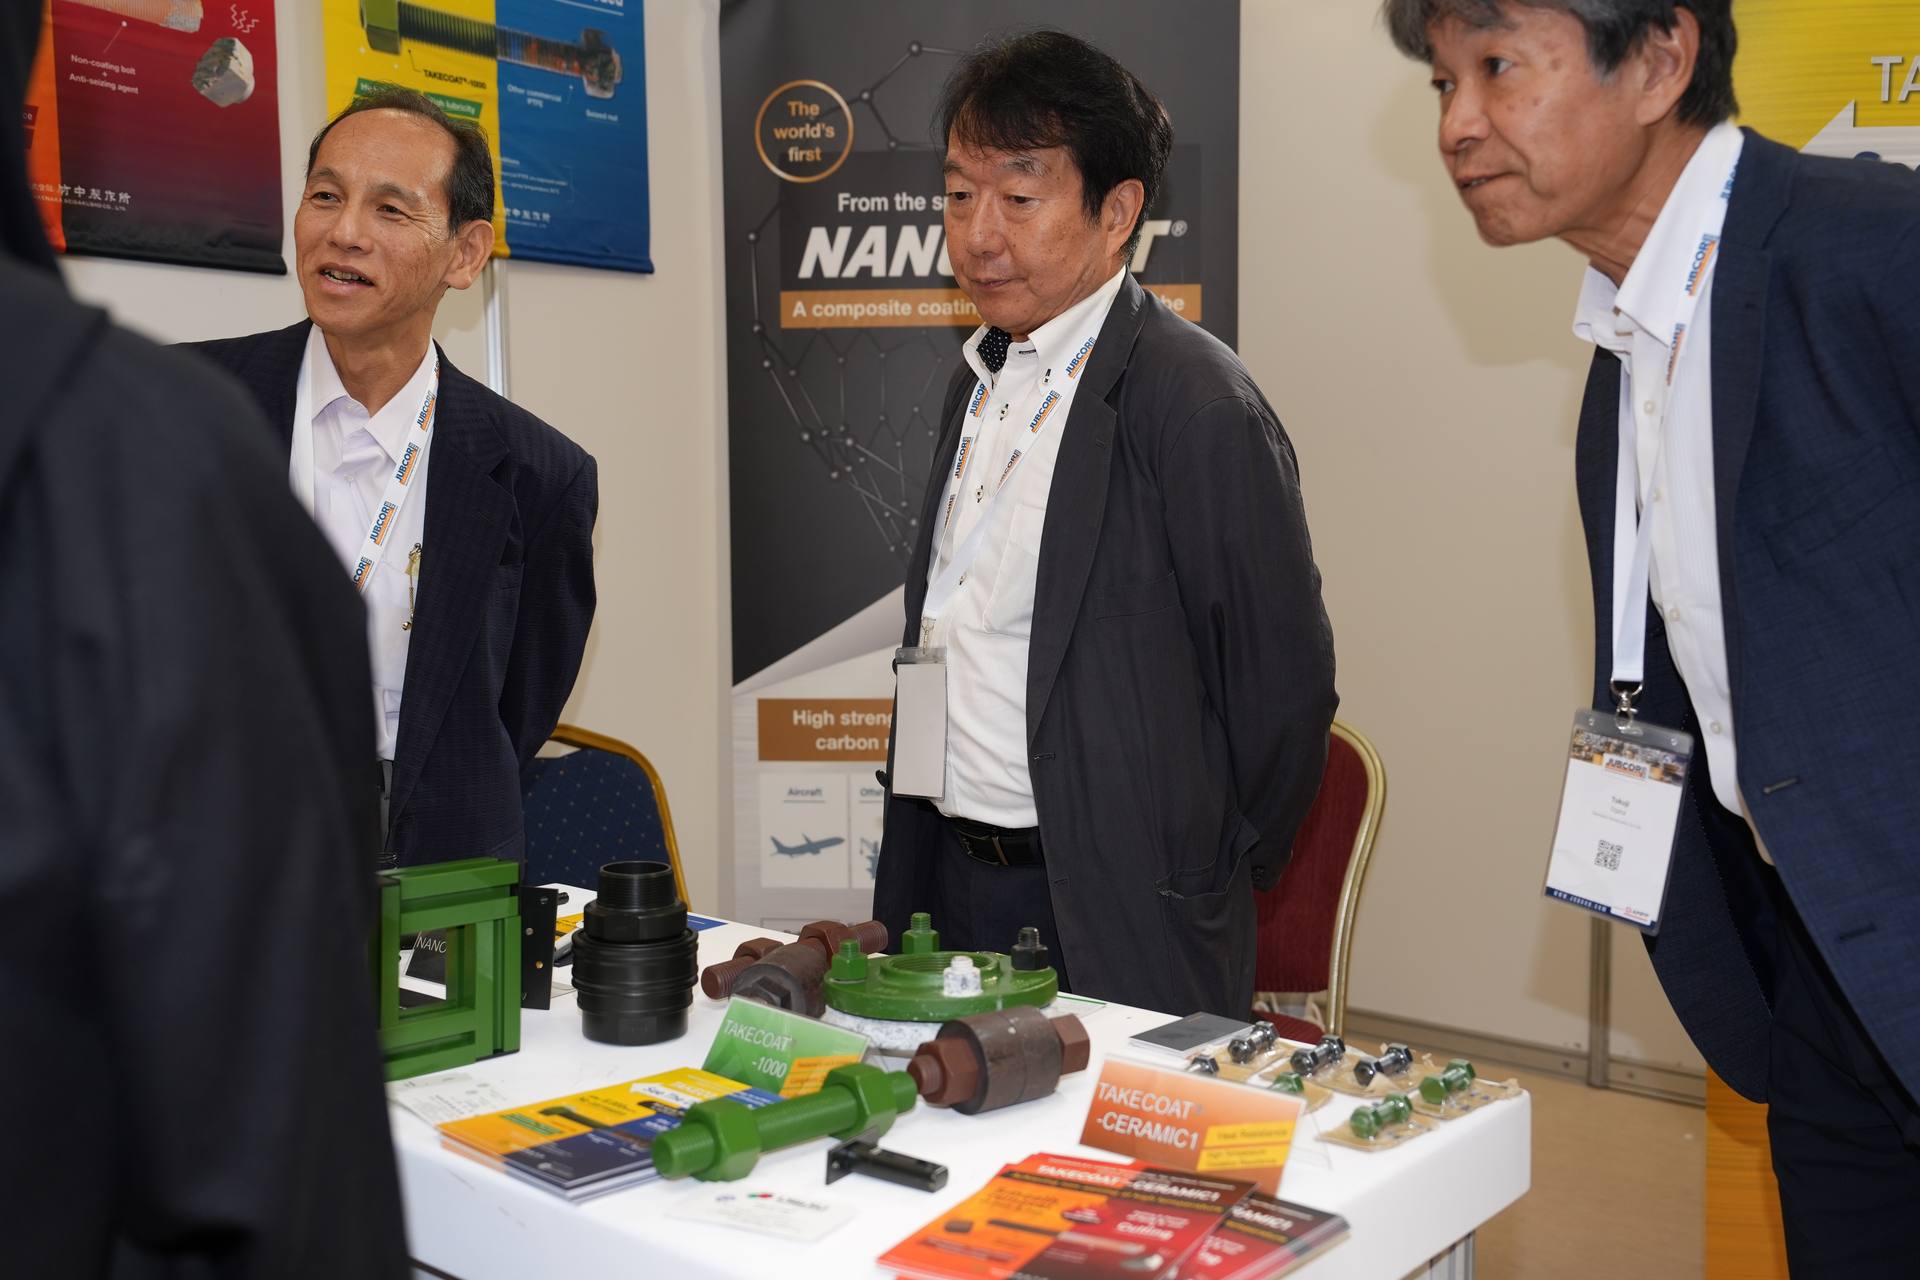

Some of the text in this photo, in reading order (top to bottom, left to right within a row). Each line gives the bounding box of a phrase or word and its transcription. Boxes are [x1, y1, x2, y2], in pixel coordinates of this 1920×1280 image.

[788, 101, 819, 117] The
[774, 123, 835, 140] world's
[789, 147, 821, 162] first
[838, 193, 889, 212] From
[895, 192, 927, 210] the
[792, 299, 978, 319] A composite coatin
[793, 710, 892, 729] High stren
[816, 735, 879, 751] carbon
[788, 787, 823, 797] Aircraft
[752, 1056, 787, 1079] -1000
[1096, 1111, 1199, 1151] -CERAMIC1
